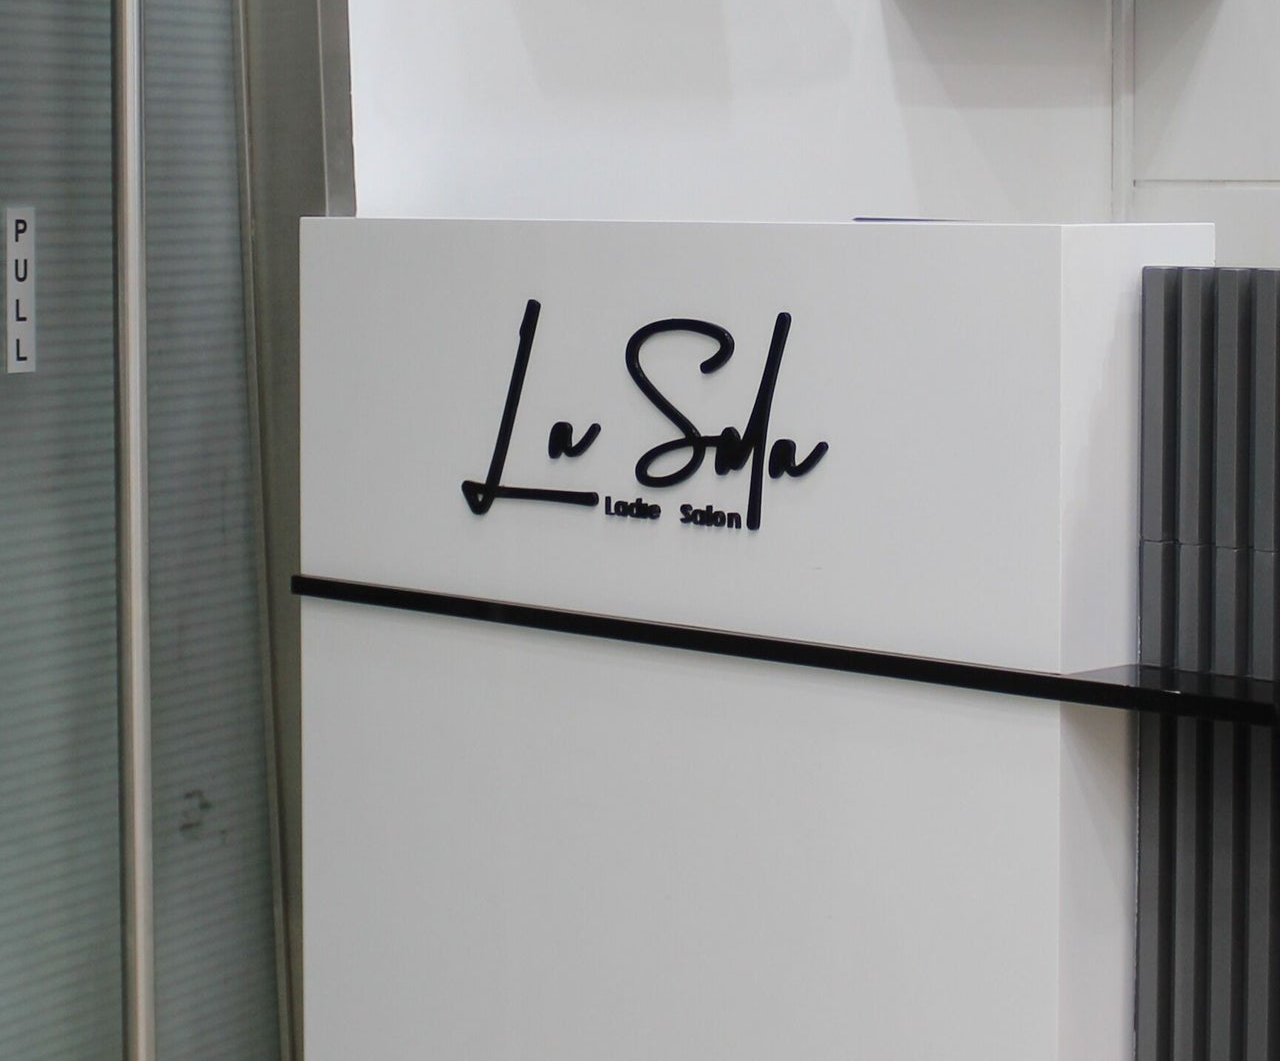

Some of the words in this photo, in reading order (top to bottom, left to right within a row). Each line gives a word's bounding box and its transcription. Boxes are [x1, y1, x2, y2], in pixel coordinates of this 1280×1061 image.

[14, 219, 28, 361] PULL
[461, 299, 601, 515] La
[679, 503, 742, 529] Salon
